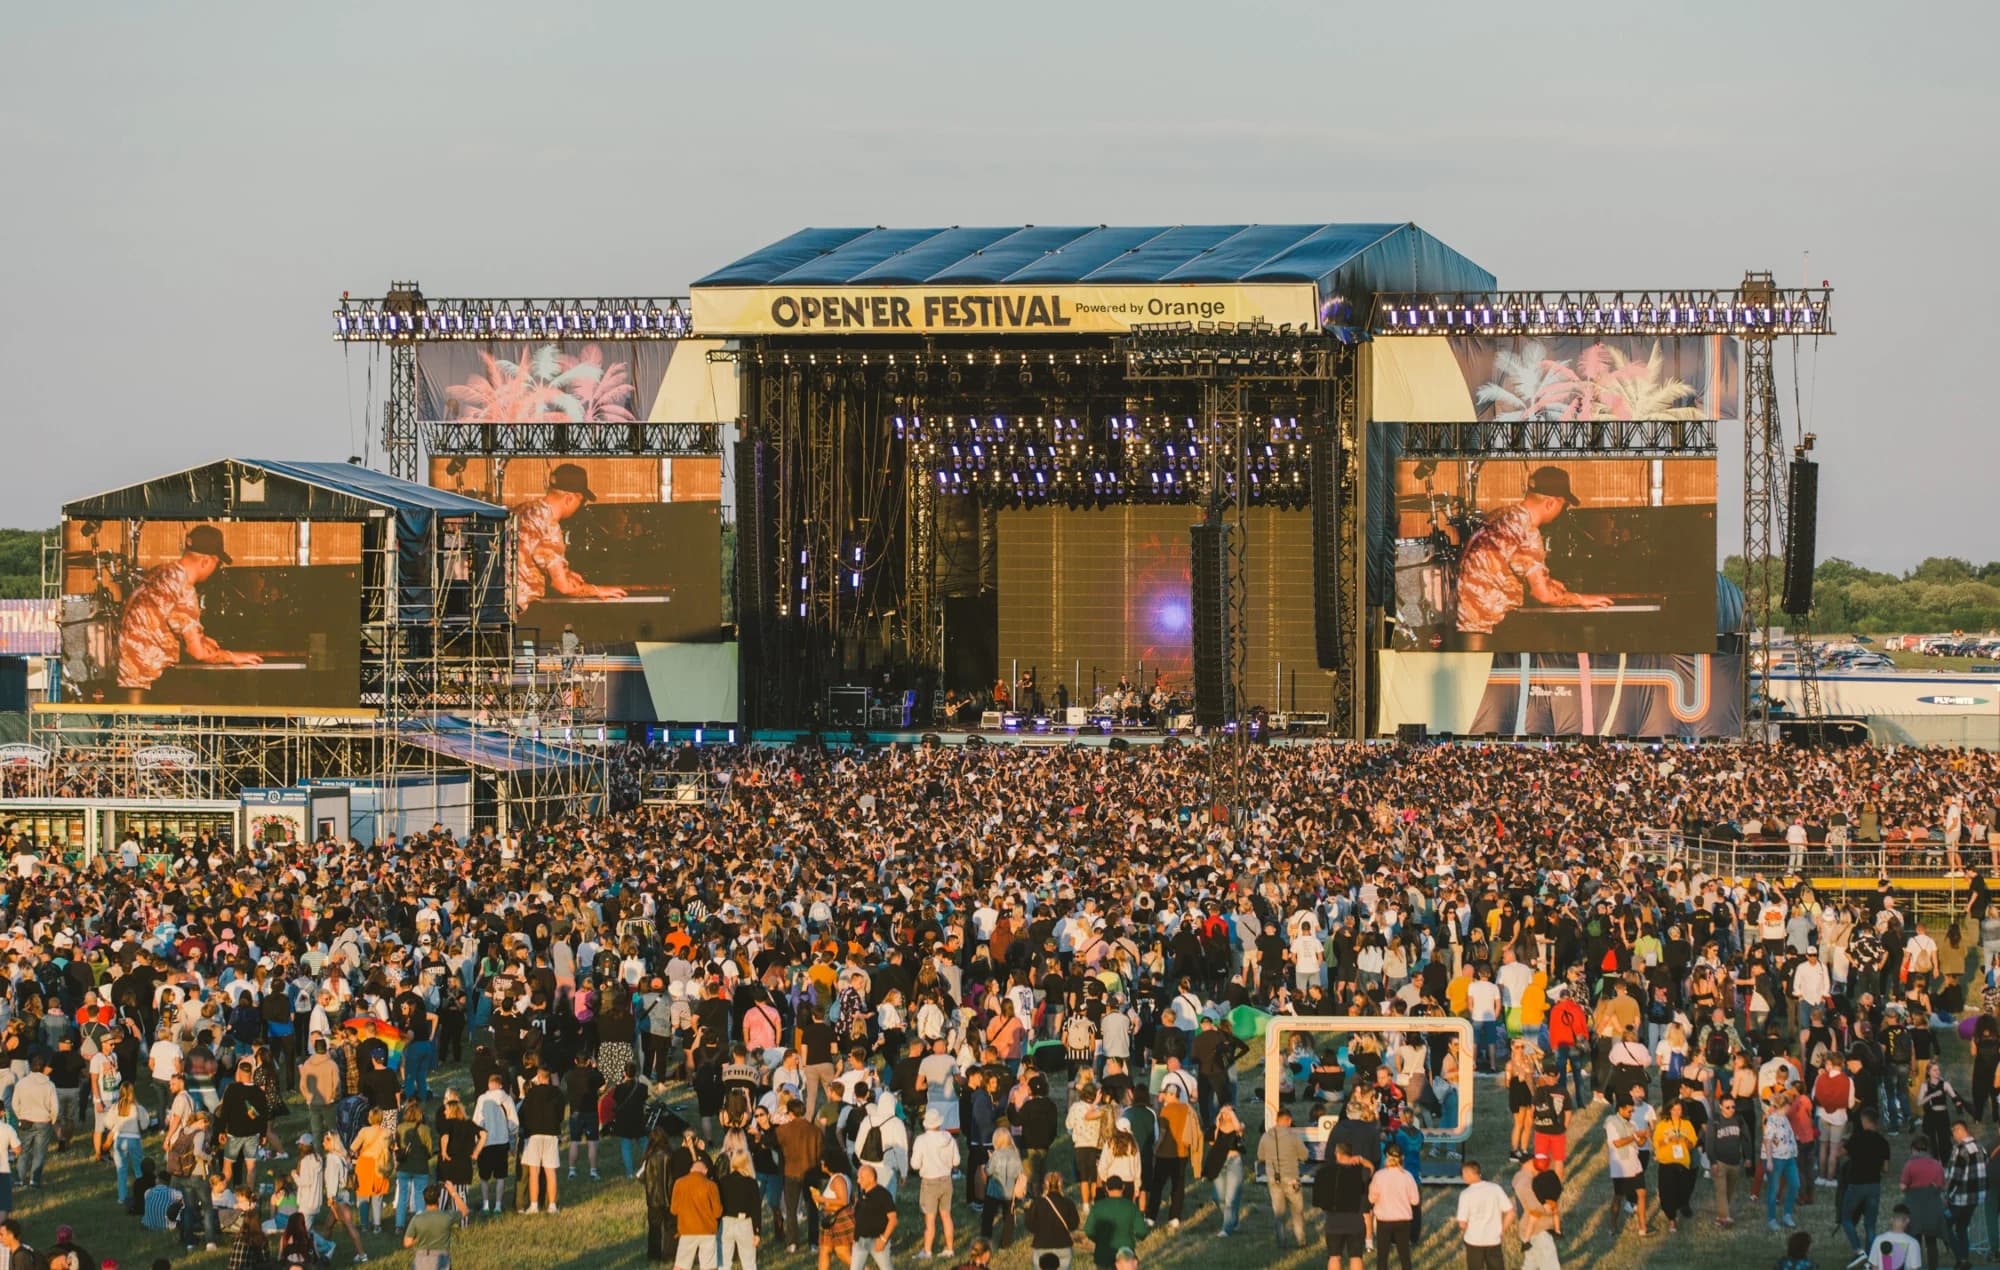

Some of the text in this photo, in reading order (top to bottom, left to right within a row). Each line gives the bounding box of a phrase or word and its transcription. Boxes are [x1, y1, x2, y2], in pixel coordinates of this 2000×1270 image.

[771, 295, 1071, 328] OPEN'ER FESTIVAL
[1075, 298, 1226, 319] Powered by Orange
